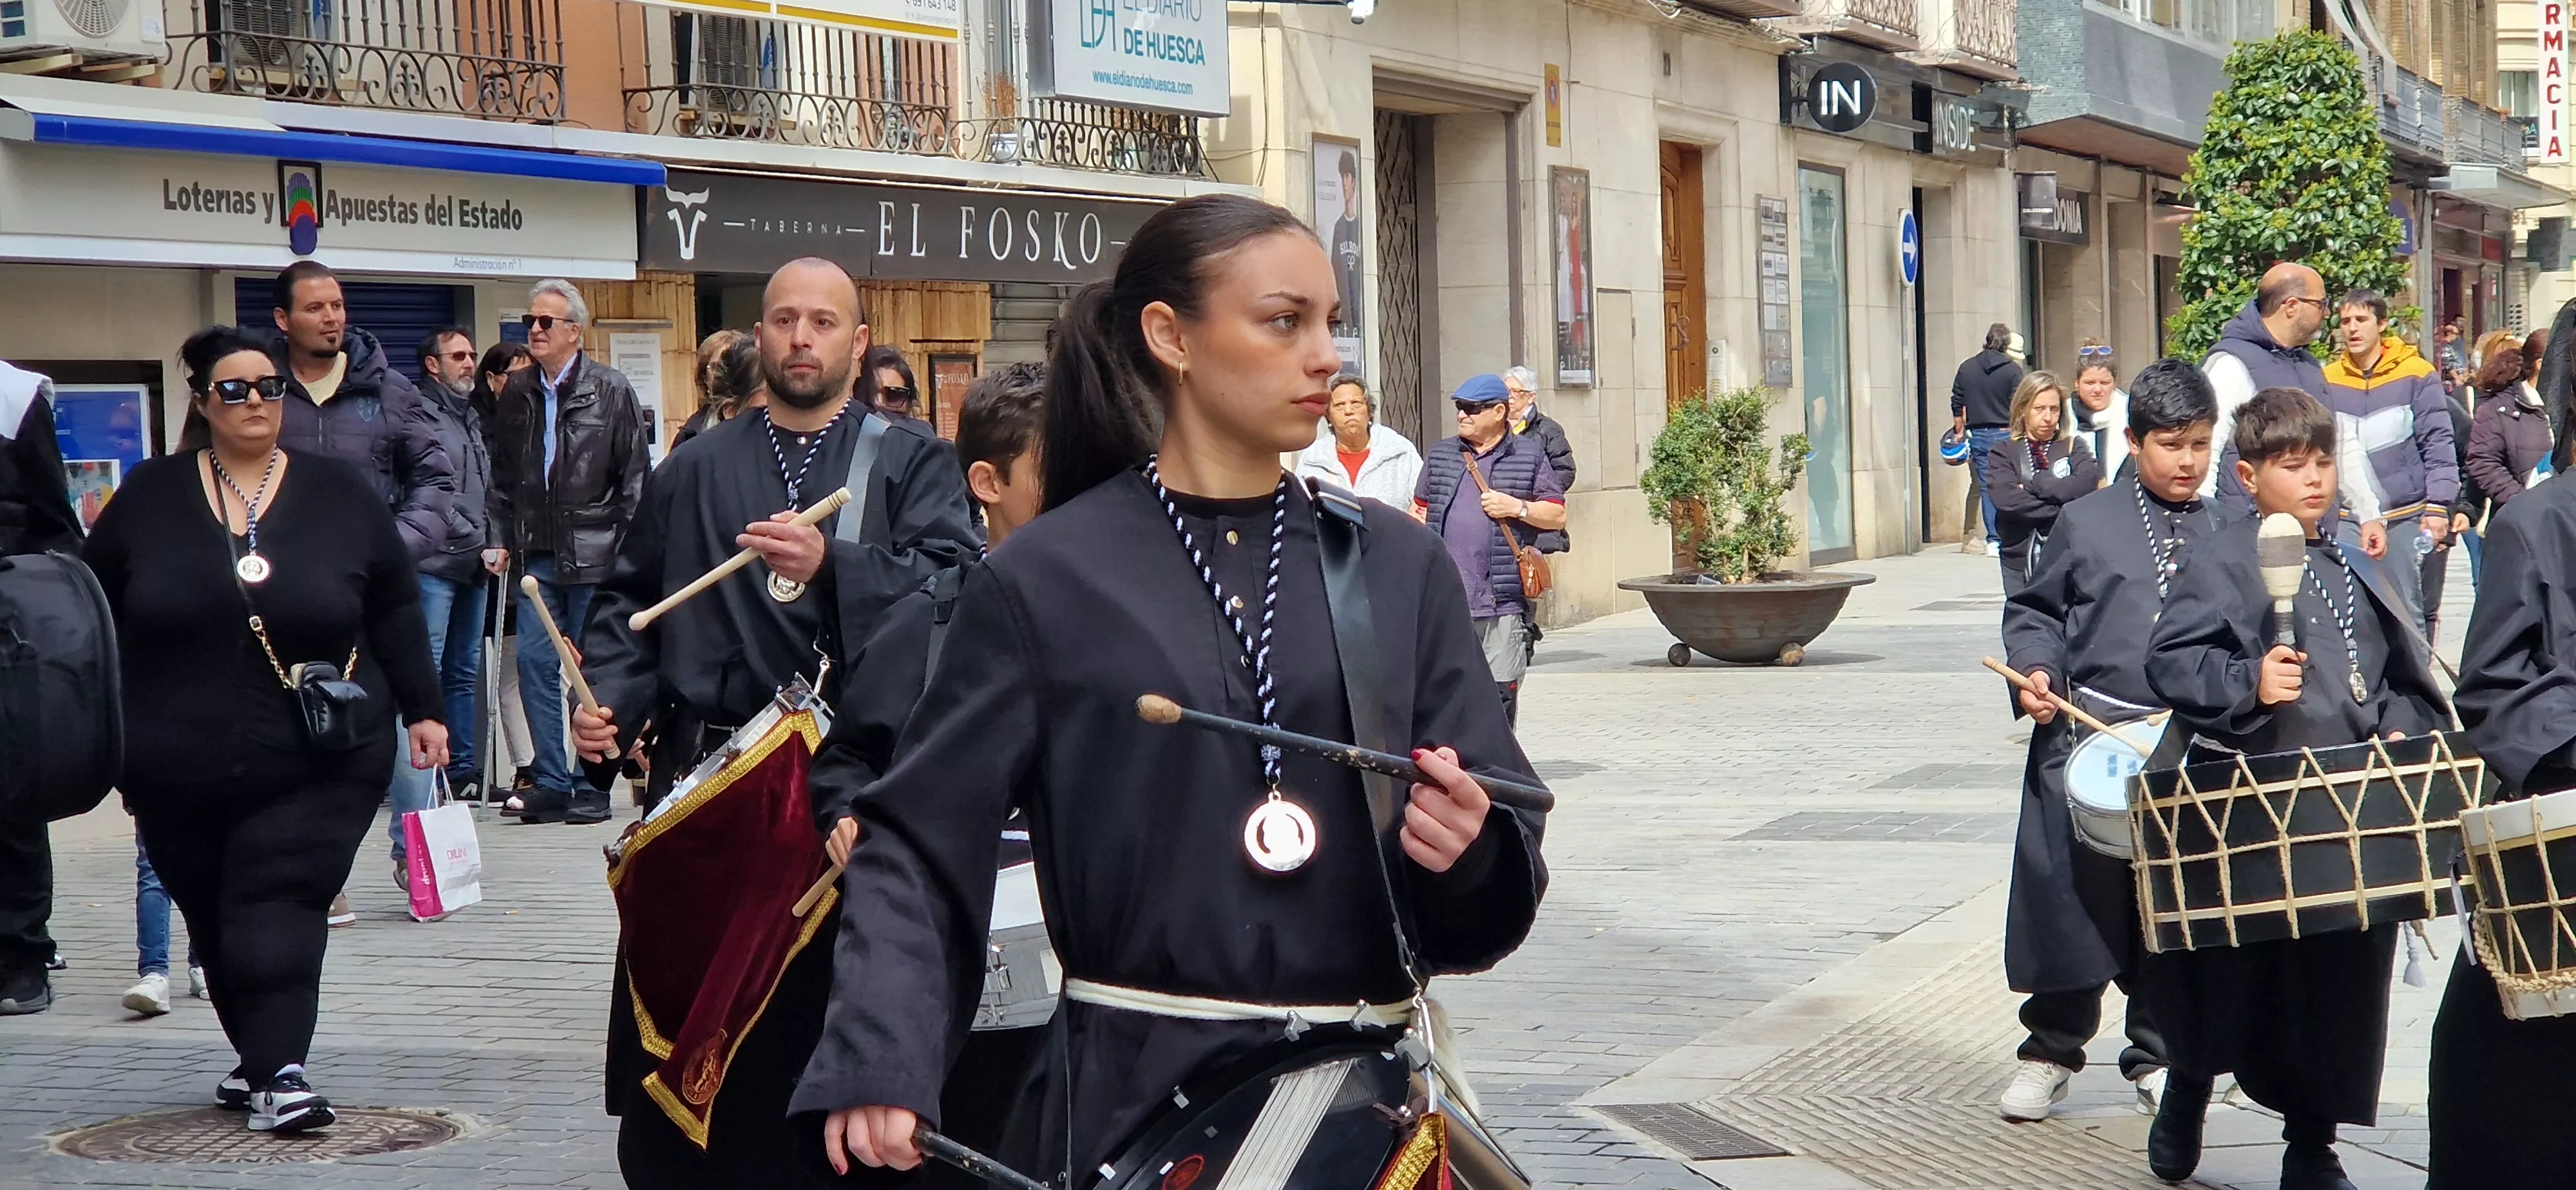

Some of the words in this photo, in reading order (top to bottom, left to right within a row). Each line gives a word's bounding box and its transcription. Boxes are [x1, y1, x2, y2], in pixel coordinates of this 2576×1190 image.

[928, 0, 941, 10] 643
[943, 0, 956, 12] 148
[1123, 27, 1144, 57] DE
[1146, 30, 1206, 66] HUESCA
[1092, 70, 1193, 95] www.eldiariodehuesca.com
[1820, 80, 1861, 116] IN
[1935, 100, 1976, 152] INSIDE
[261, 192, 274, 224] y
[325, 189, 419, 226] Apuestas
[424, 194, 453, 227] del
[458, 198, 522, 231] Estado
[750, 218, 841, 234] TABERNA
[878, 200, 927, 257] EL
[959, 206, 1102, 270] FOSKO
[453, 256, 507, 270] Administración
